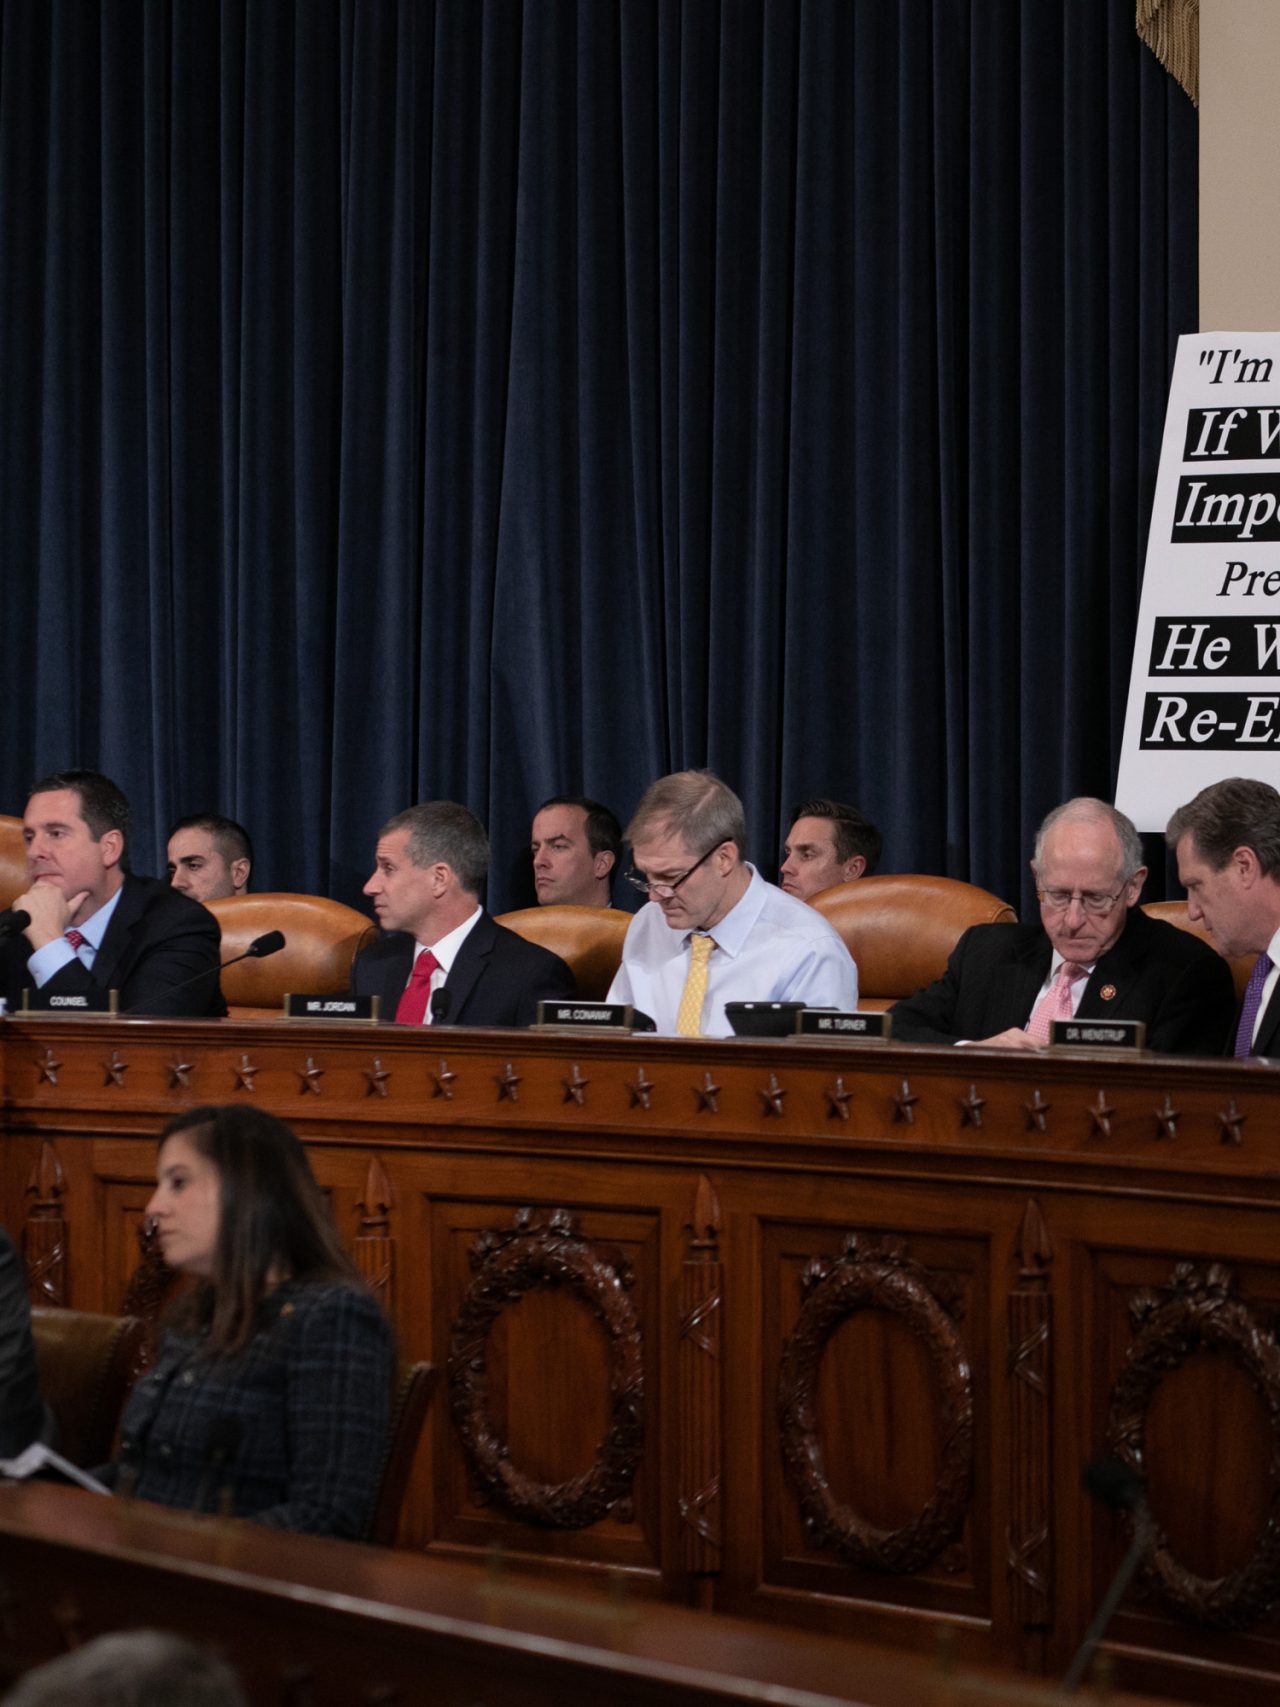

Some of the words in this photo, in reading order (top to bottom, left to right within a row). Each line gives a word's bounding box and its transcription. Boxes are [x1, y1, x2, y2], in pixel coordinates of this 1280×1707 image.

[1197, 348, 1272, 384] "I'm
[1190, 407, 1246, 456] If
[1155, 624, 1231, 671] He
[50, 996, 88, 1007] COUNSEL
[307, 1002, 321, 1012] MR.
[322, 1002, 356, 1013] JORDAN
[558, 1010, 571, 1019] MR.
[573, 1009, 612, 1021] CONAWAY
[819, 1019, 833, 1029] MR.
[834, 1020, 866, 1031] TURNER
